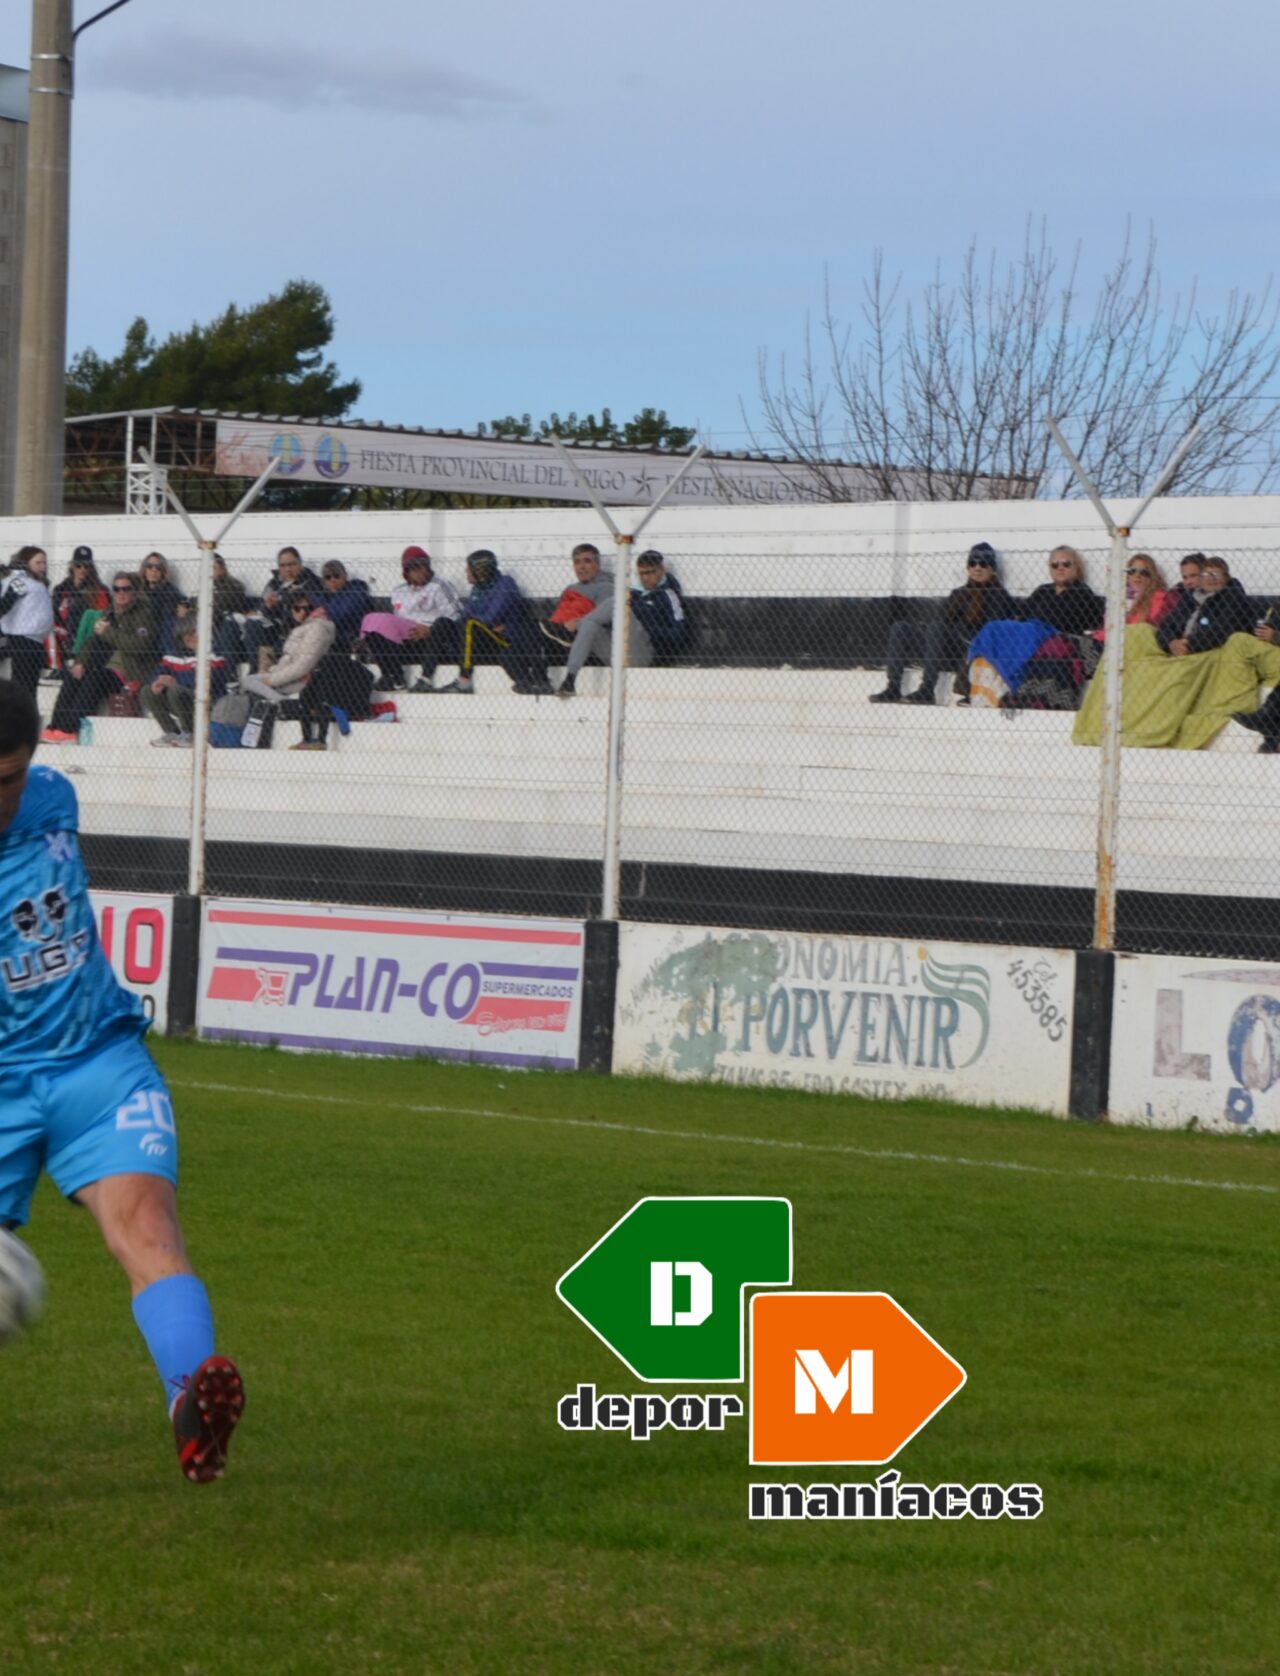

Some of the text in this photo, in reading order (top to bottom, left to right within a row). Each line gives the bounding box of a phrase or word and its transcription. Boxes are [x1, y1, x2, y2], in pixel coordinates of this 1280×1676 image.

[360, 450, 417, 474] FIESTA
[421, 456, 529, 485] PROVINCIAL
[533, 465, 568, 486] DEL
[282, 951, 482, 1021] PLAN-CO
[482, 981, 574, 999] SUPERMERCADOS
[1006, 959, 1068, 1042] 453585
[741, 984, 960, 1070] PORVENIR
